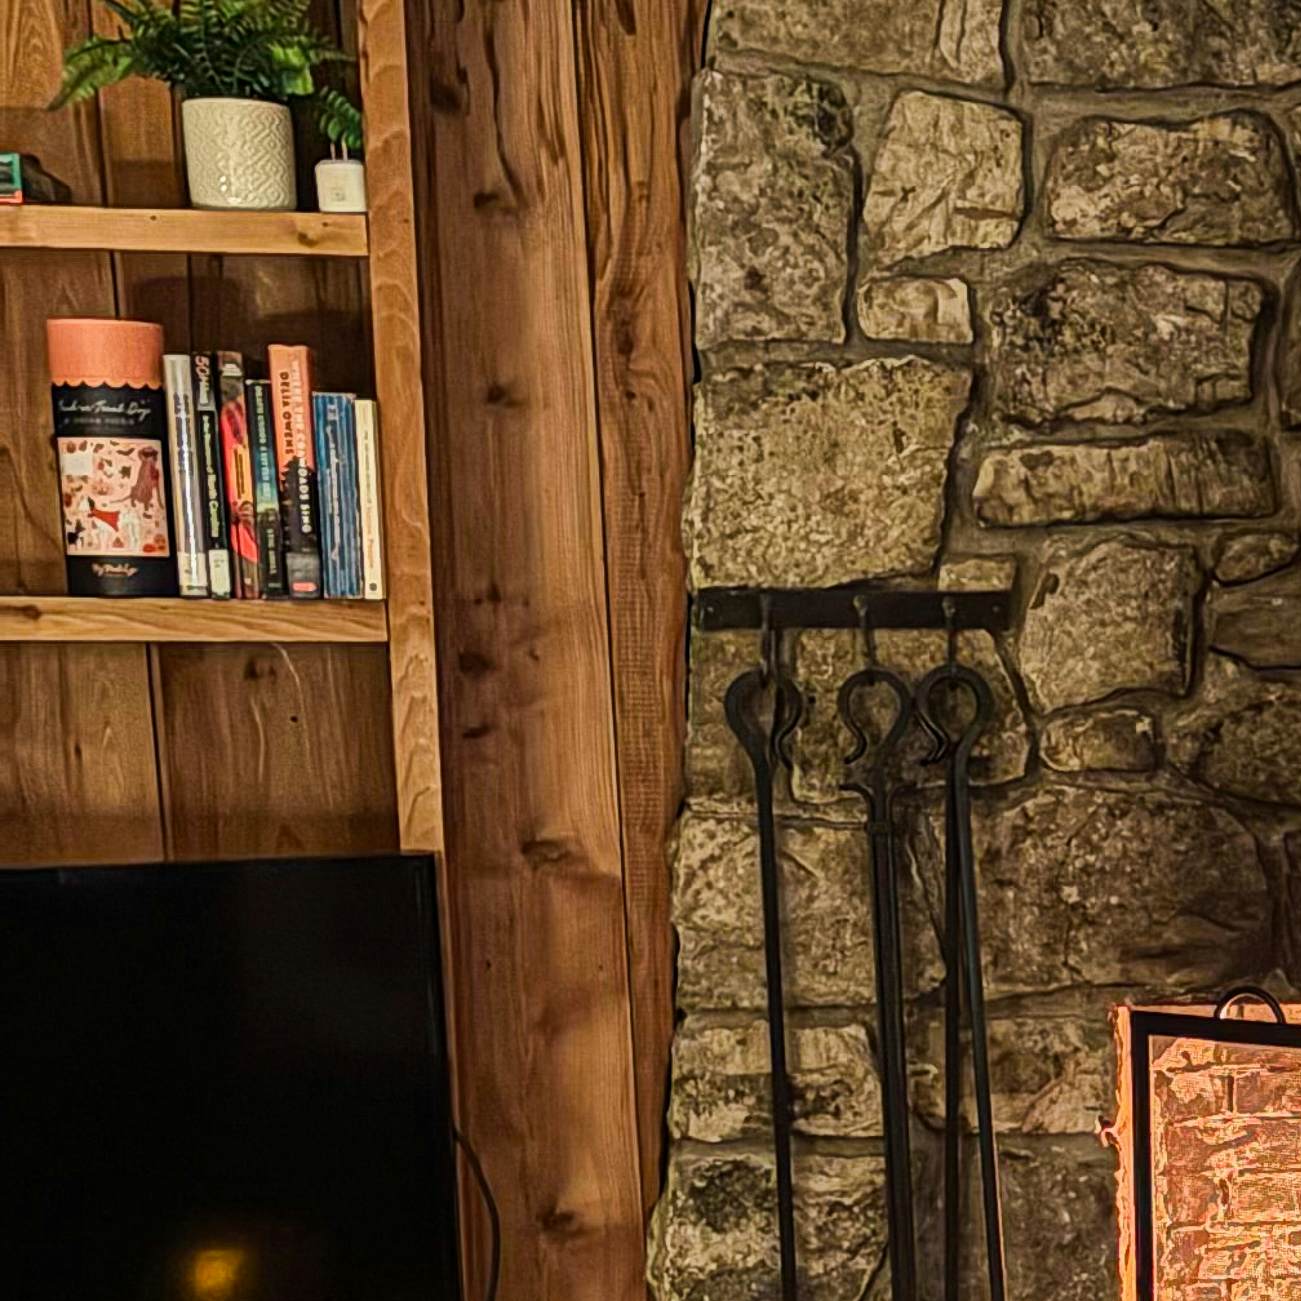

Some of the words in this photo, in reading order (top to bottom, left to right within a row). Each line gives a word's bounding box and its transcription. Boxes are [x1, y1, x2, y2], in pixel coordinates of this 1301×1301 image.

[280, 371, 292, 407] DELIA
[283, 412, 295, 455] OWENS
[300, 503, 312, 534] SING
